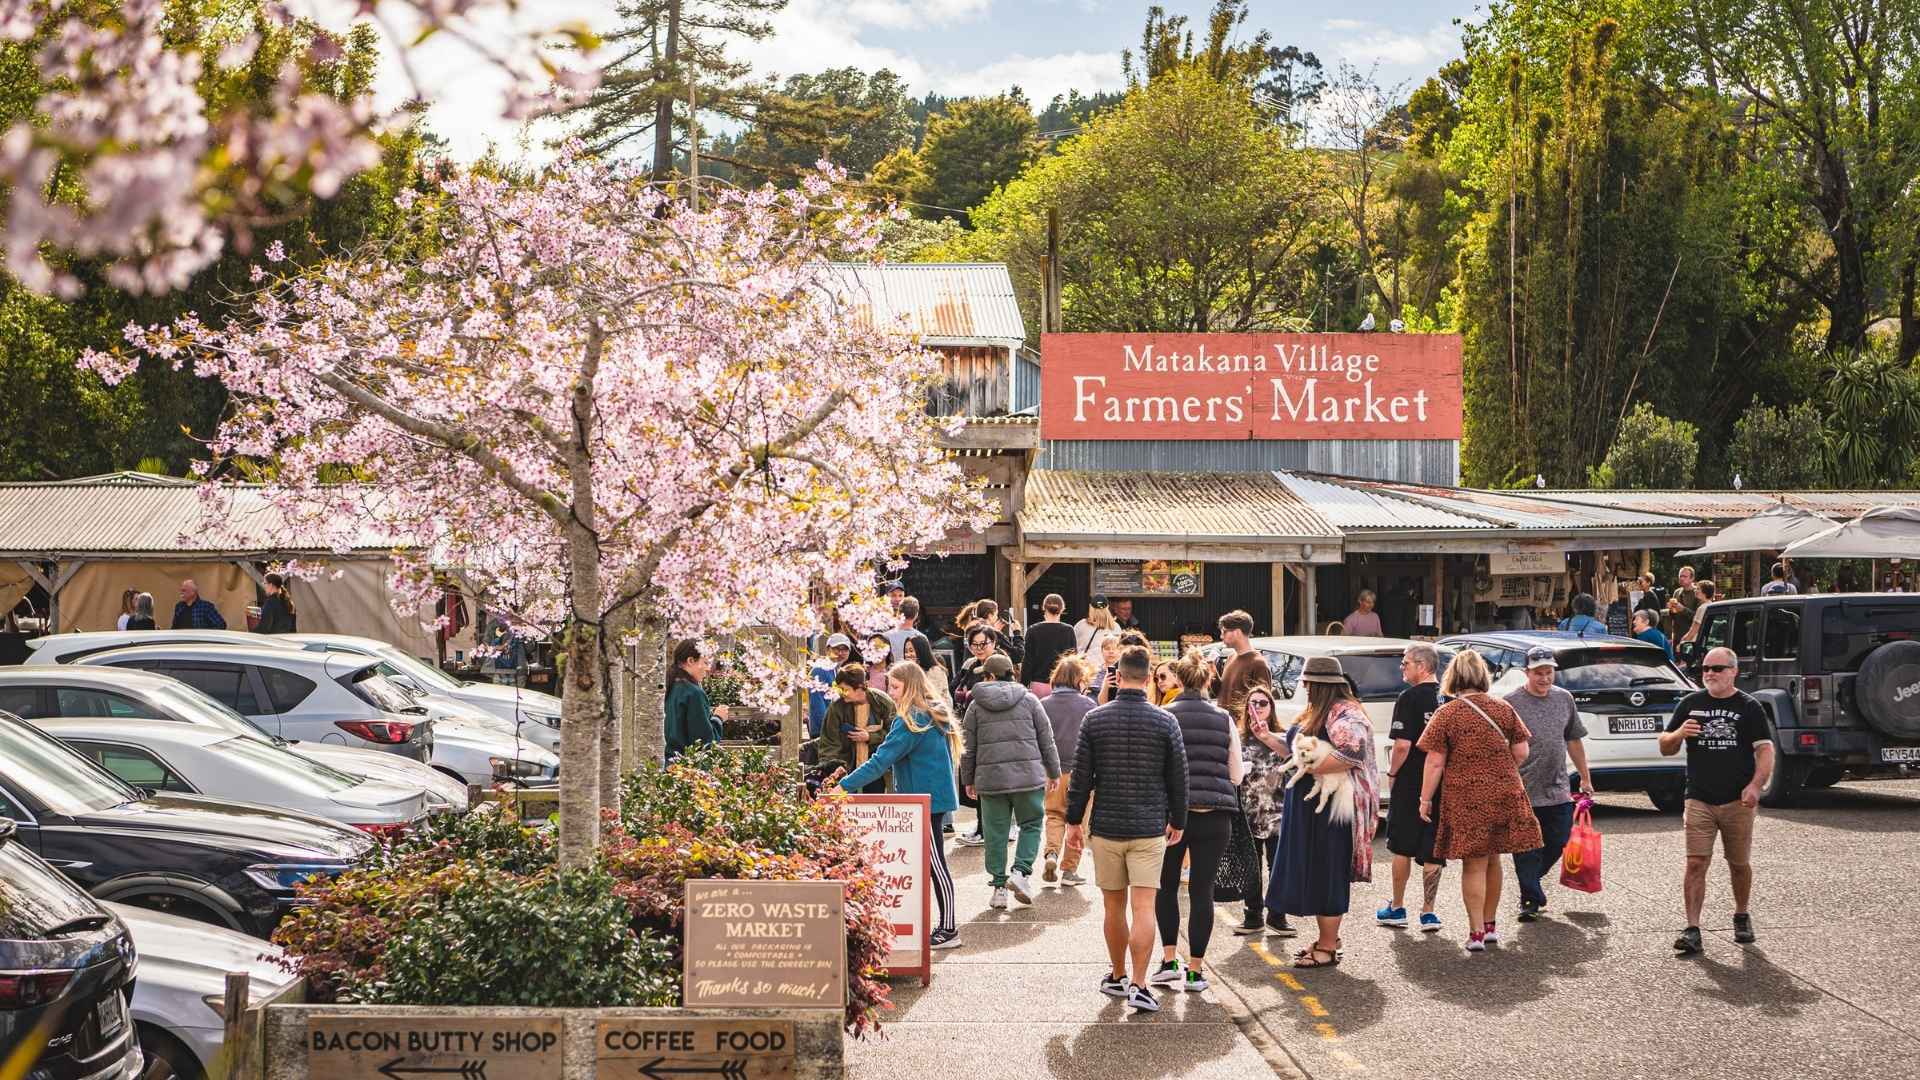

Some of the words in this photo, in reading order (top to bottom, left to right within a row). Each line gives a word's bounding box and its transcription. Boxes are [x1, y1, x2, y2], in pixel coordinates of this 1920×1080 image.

[1122, 344, 1267, 373] Matakana
[1274, 344, 1380, 383] Village
[1073, 375, 1252, 422] Farmers'
[1270, 378, 1430, 422] Market
[1893, 681, 1920, 701] Jee
[1617, 717, 1655, 731] NRH105
[878, 806, 914, 824] Village
[876, 820, 914, 833] Market
[701, 903, 755, 918] ZERO
[761, 903, 830, 919] WASTE
[725, 922, 806, 938] MARKET
[760, 960, 775, 968] THE
[695, 976, 750, 999] Thanks
[753, 981, 773, 995] so
[312, 1030, 400, 1051] BACON
[407, 1031, 484, 1051] BUTTY
[492, 1031, 557, 1052] SHOP
[604, 1030, 695, 1051] COFFEE
[716, 1031, 786, 1051] FOOD
